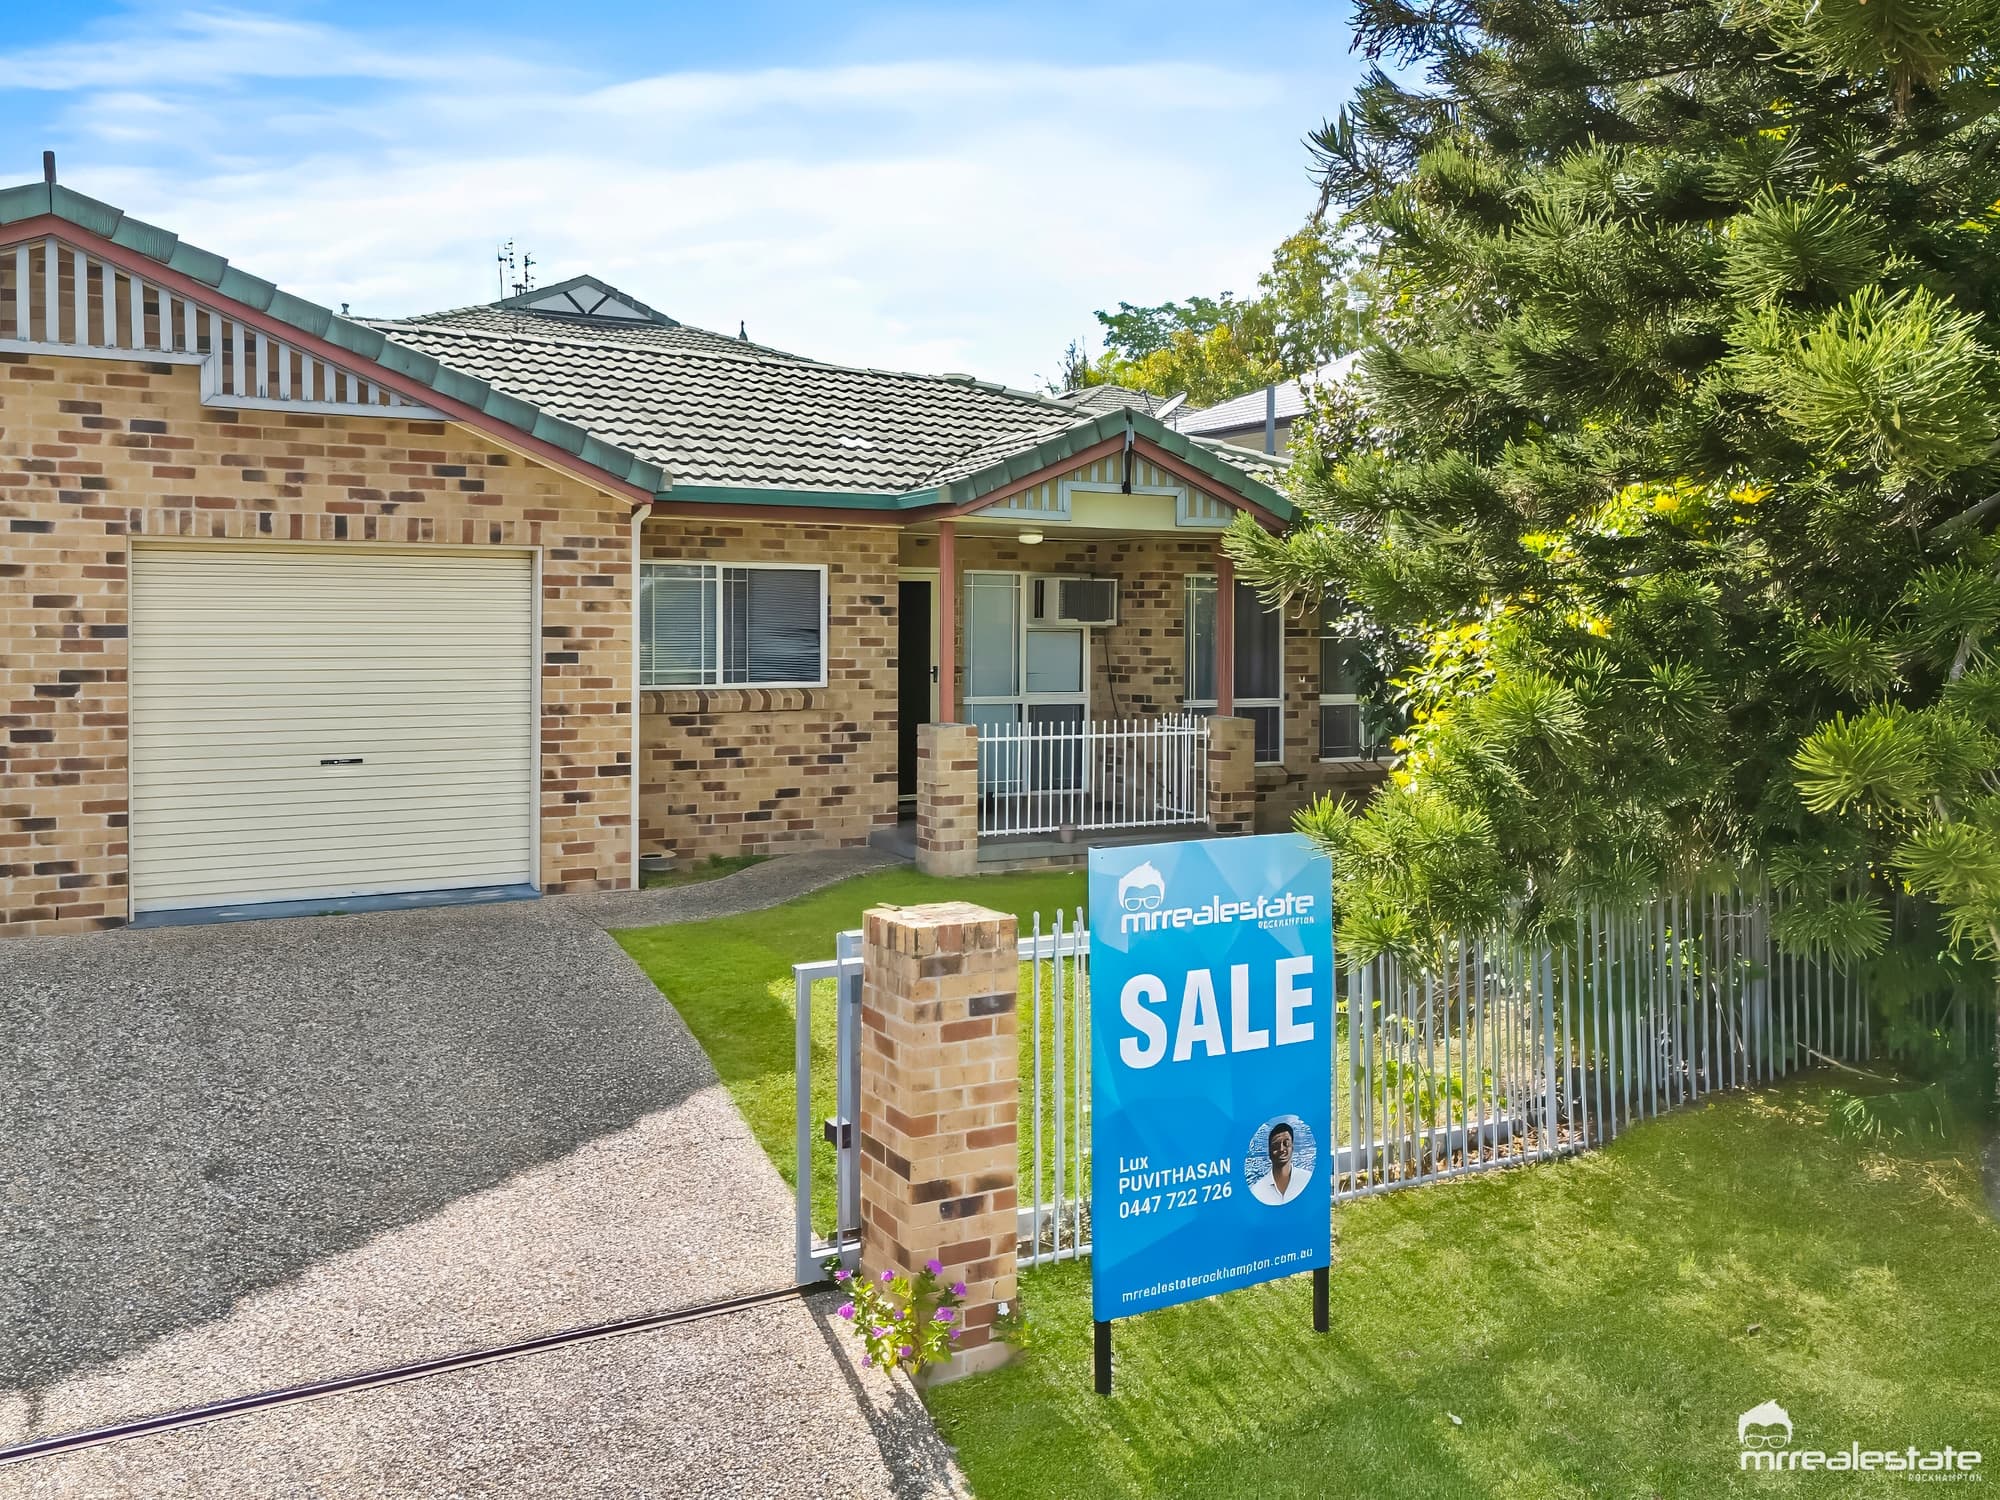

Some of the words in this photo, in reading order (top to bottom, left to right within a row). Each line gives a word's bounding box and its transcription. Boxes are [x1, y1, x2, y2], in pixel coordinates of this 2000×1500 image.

[1120, 892, 1315, 934] mrrealestate
[1119, 955, 1315, 1069] SALE
[1118, 1157, 1231, 1195] PUVITHASAN
[1119, 1156, 1149, 1174] Lux
[1119, 1195, 1161, 1219] 0447
[1167, 1190, 1198, 1210] 722
[1201, 1181, 1232, 1203] 726
[1122, 1248, 1313, 1304] mrrealestaterockhampton.com.au
